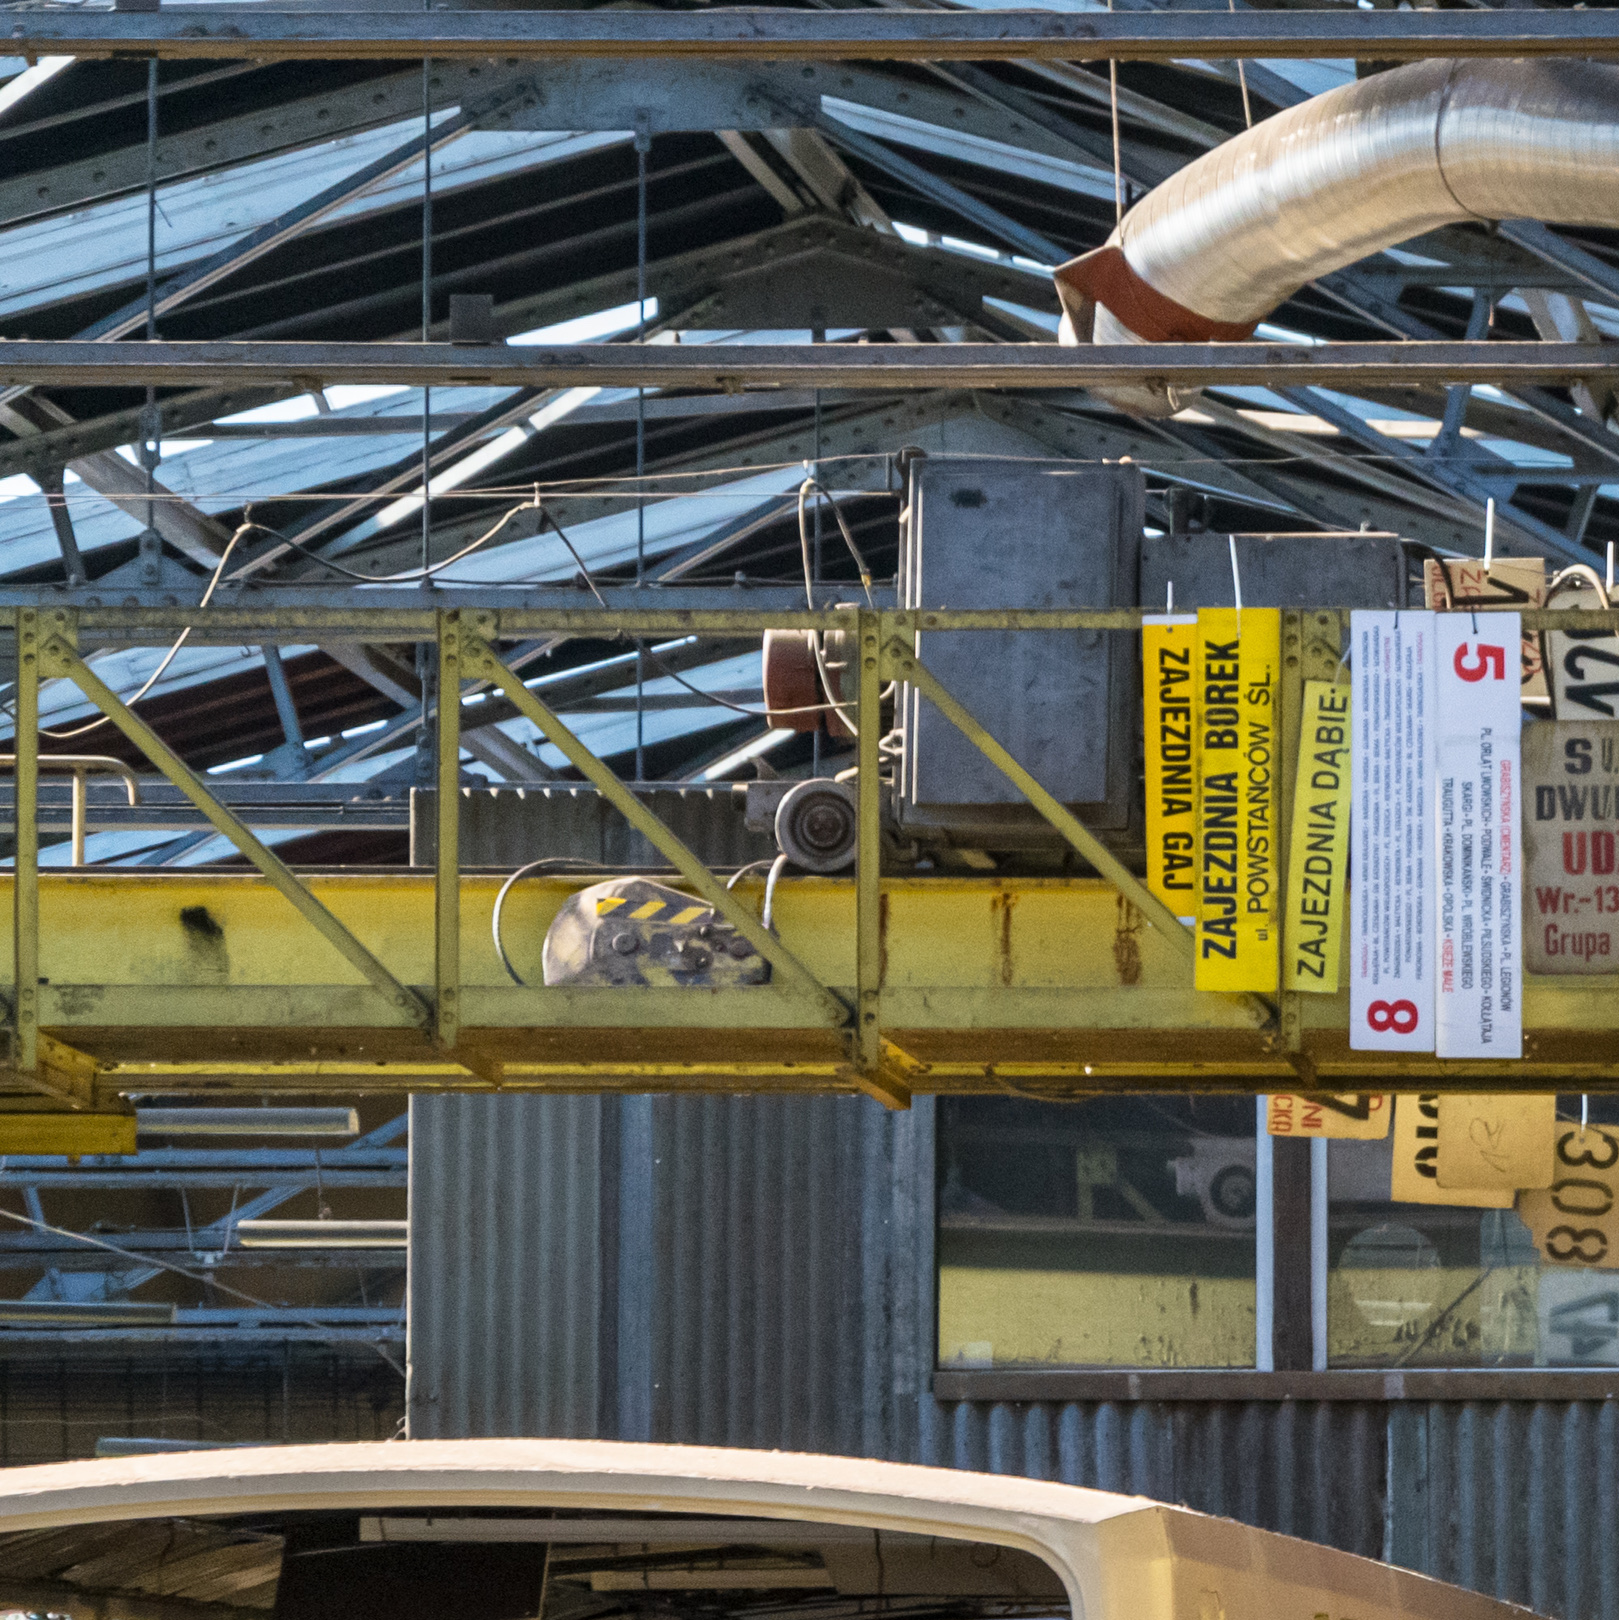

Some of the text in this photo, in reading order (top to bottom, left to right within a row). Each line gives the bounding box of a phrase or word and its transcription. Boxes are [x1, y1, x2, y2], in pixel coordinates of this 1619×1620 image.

[1454, 642, 1505, 682] 5
[1159, 648, 1194, 891] ZAJEZDNIA GAJ
[1203, 639, 1239, 960] ZAJEZDNIA BOREK
[1247, 663, 1272, 941] ul. POWSTAŃCÓW ŚL.
[1298, 796, 1337, 978] ZAJEZDNIA
[1544, 923, 1610, 960] Grupa
[1367, 998, 1418, 1035] 8
